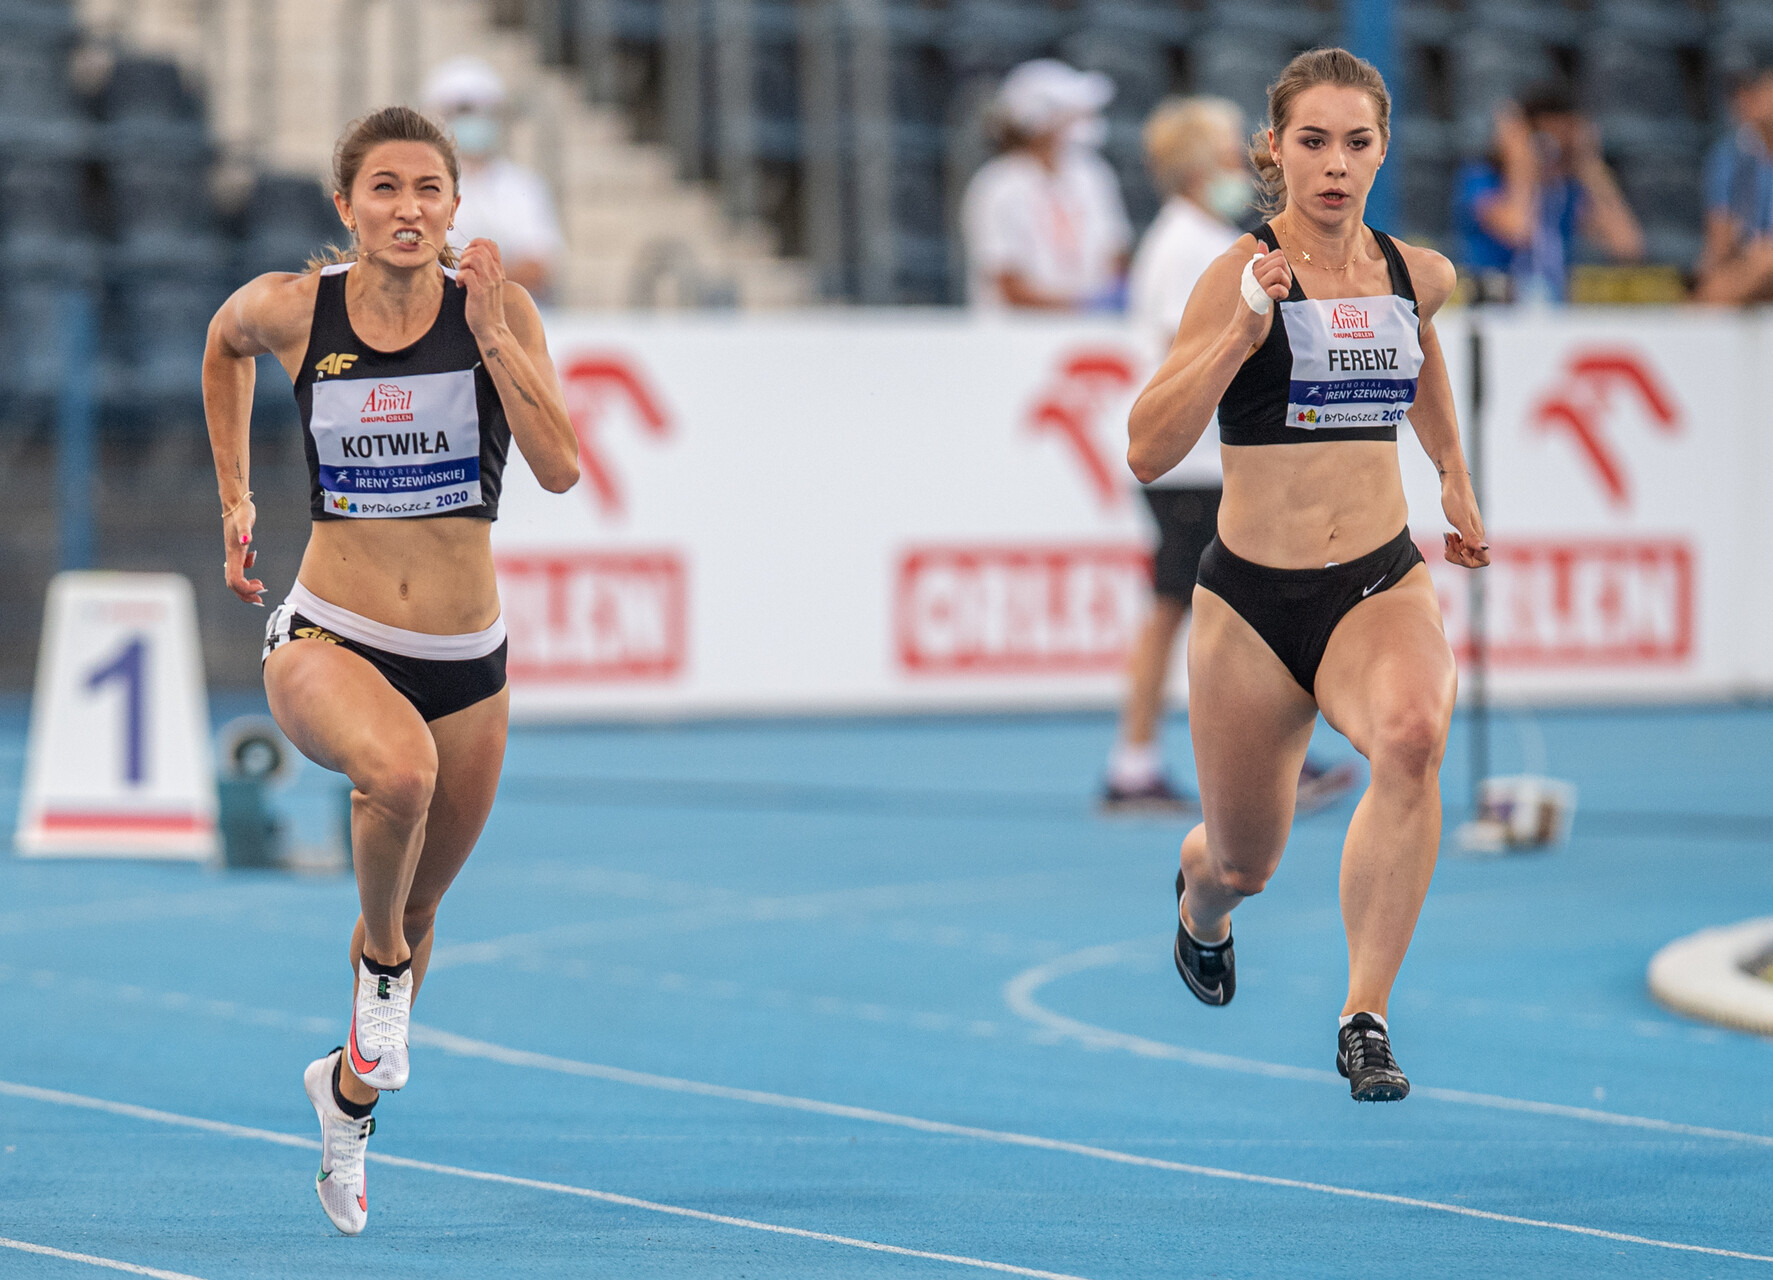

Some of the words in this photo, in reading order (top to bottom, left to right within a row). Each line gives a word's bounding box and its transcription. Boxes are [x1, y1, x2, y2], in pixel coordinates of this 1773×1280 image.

[1331, 307, 1369, 329] Anwil
[1352, 331, 1374, 339] ORLEN
[315, 352, 359, 374] 4F
[1328, 348, 1399, 371] FERENZ
[361, 387, 413, 412] Anwil
[1325, 390, 1353, 400] IRENY
[361, 416, 385, 424] GRUPA
[387, 414, 413, 422] ORLEN
[1324, 413, 1378, 422] BYDGOSZCZ
[341, 430, 450, 459] KOTWIŁA
[355, 477, 389, 489] IRENY
[392, 468, 465, 488] SZEWIŃSKIEJ
[361, 502, 431, 513] BYDGOSZCZ
[435, 490, 469, 508] 2020
[84, 634, 150, 788] 1
